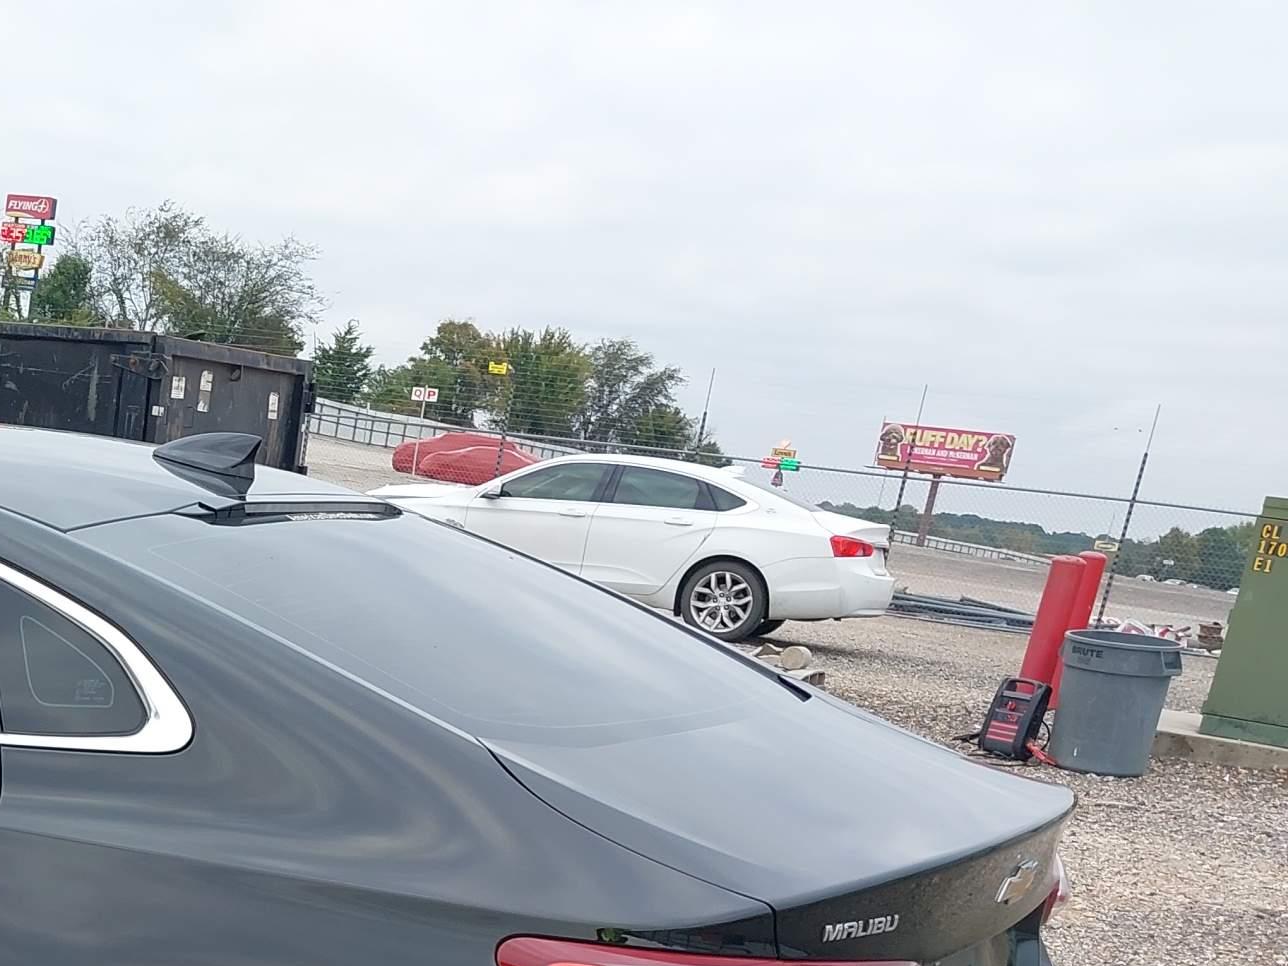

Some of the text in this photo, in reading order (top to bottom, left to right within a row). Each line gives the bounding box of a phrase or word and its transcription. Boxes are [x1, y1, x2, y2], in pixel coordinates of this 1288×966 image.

[8, 200, 38, 211] FLYING
[414, 388, 436, 400] Q P
[945, 432, 987, 452] DAY?
[1262, 524, 1281, 539] CL
[1072, 645, 1104, 658] BRUTE
[822, 914, 899, 943] MALIBU
